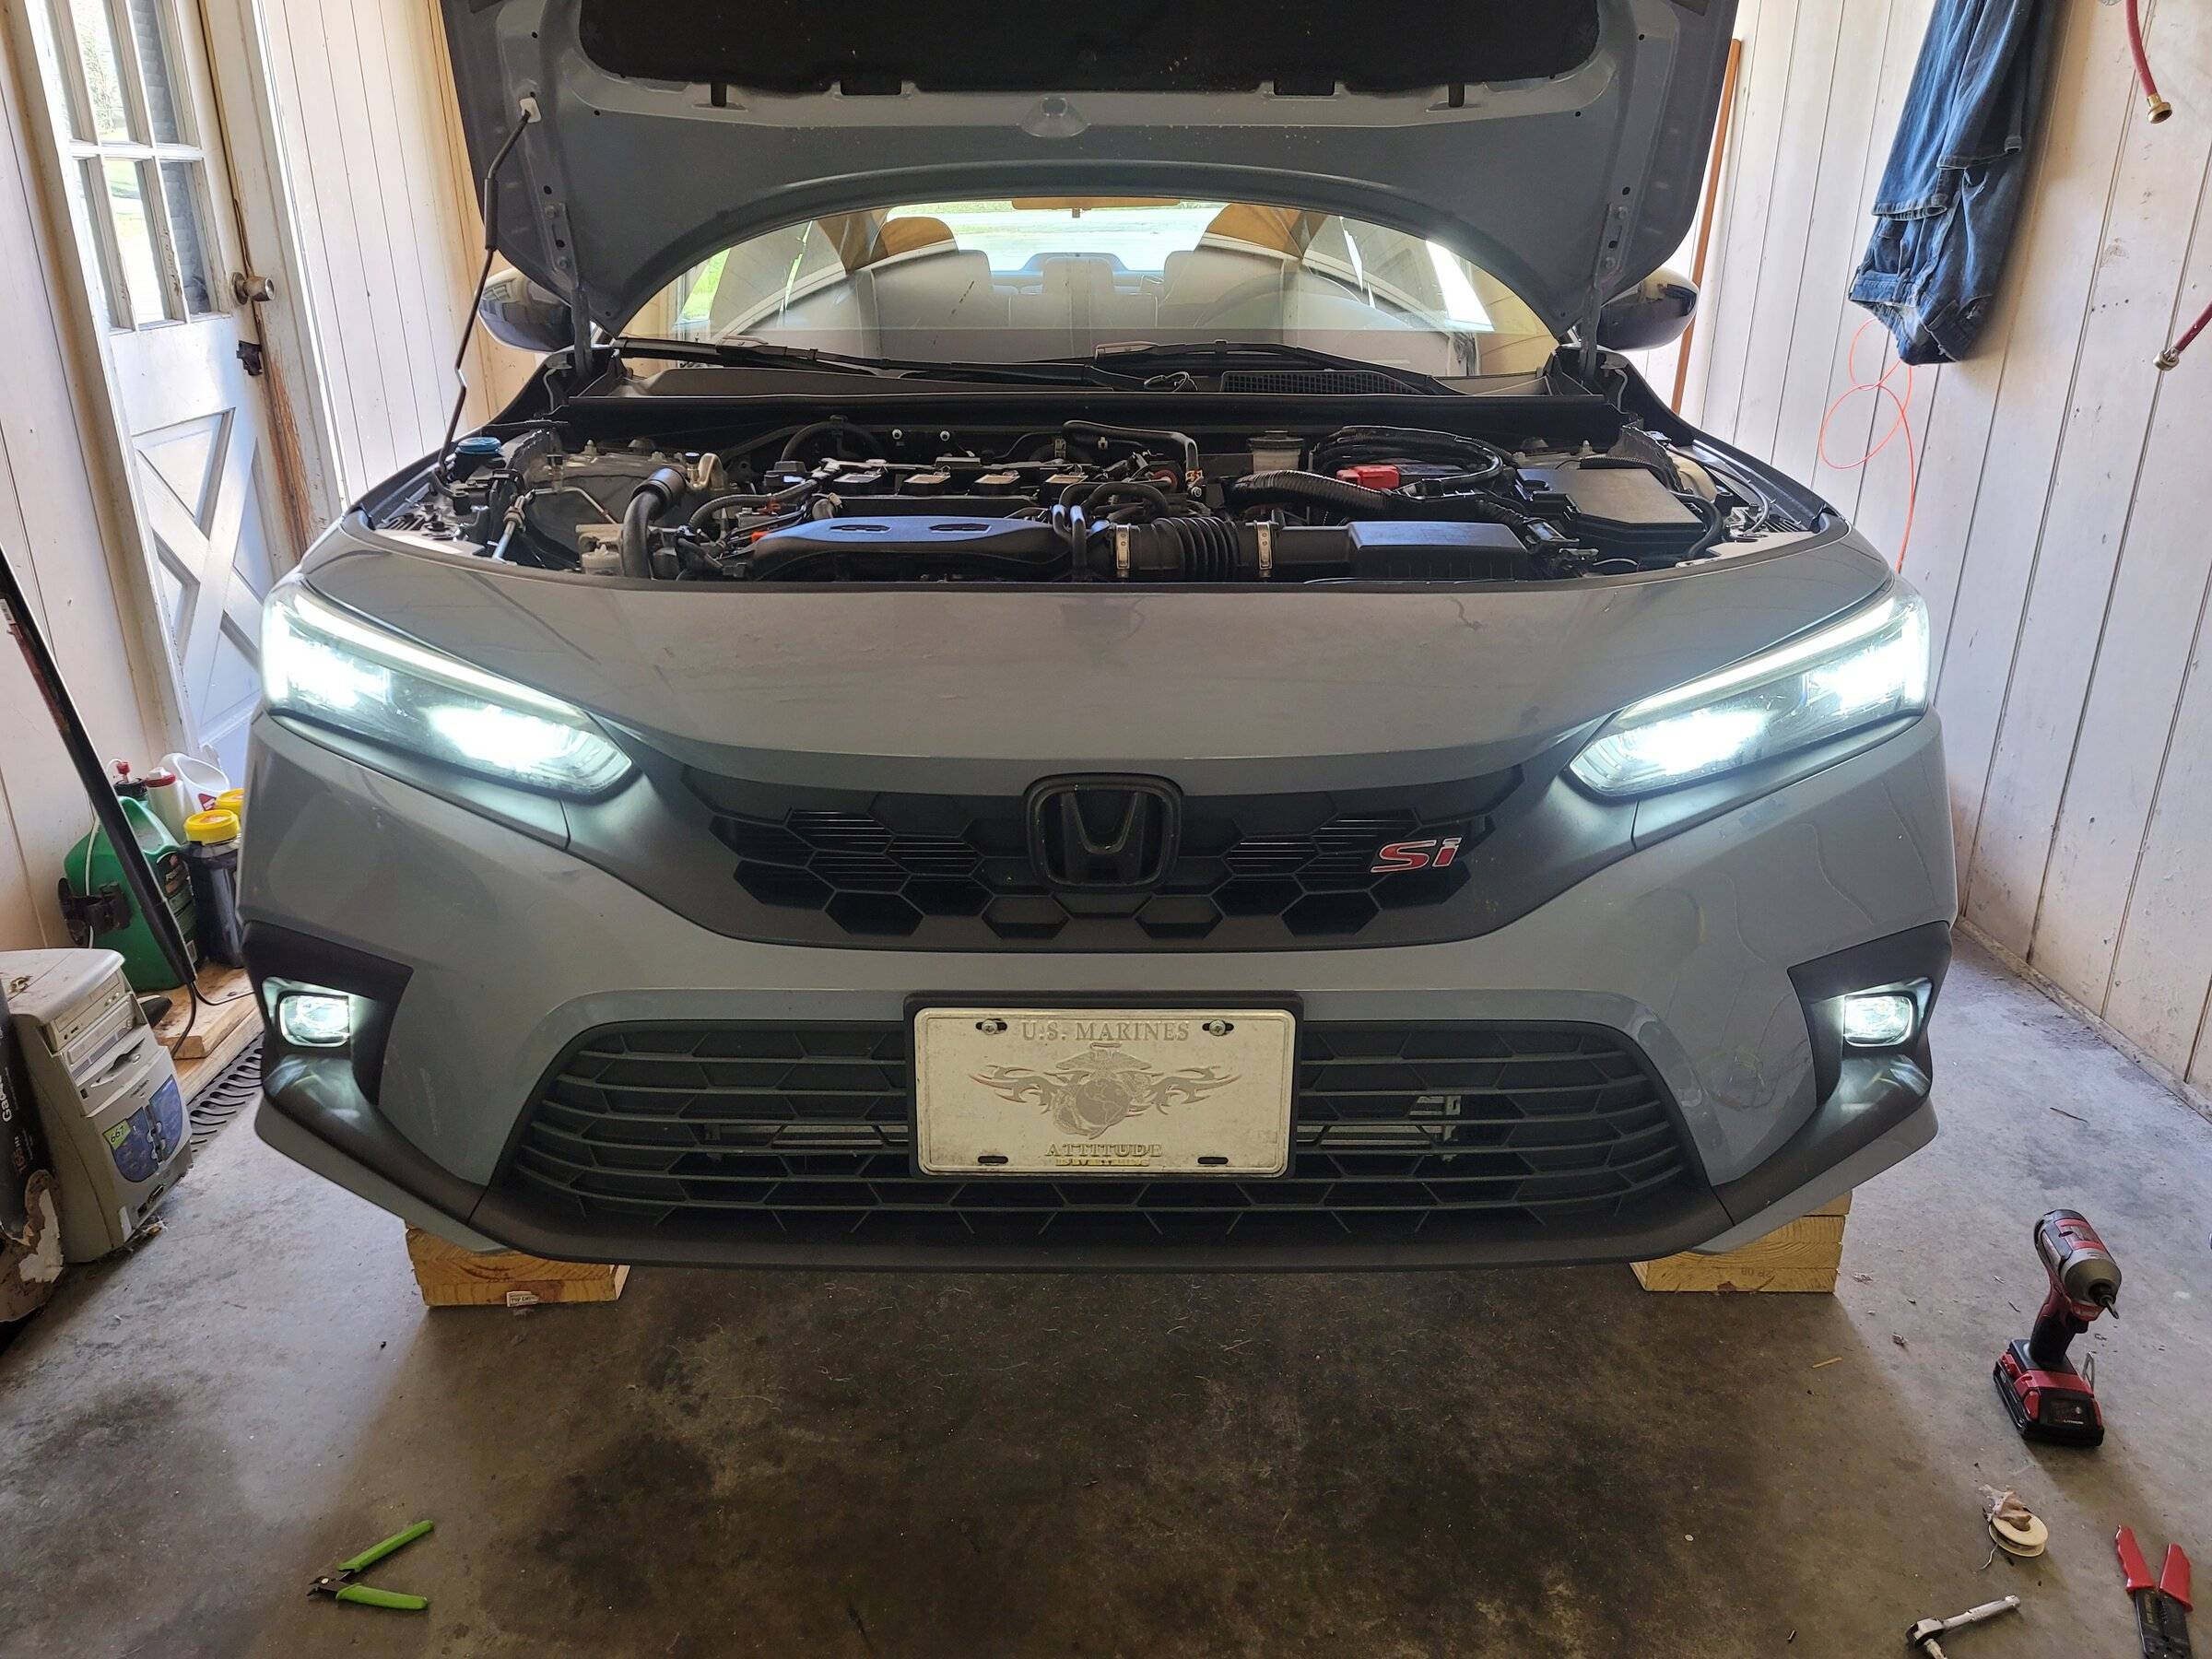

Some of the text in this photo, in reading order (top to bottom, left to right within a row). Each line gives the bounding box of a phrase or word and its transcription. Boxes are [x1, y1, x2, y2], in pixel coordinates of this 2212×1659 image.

[1371, 837, 1462, 873] Si
[1022, 1021, 1190, 1041] U.S. MARINES
[1044, 1143, 1163, 1158] ATTITUDE
